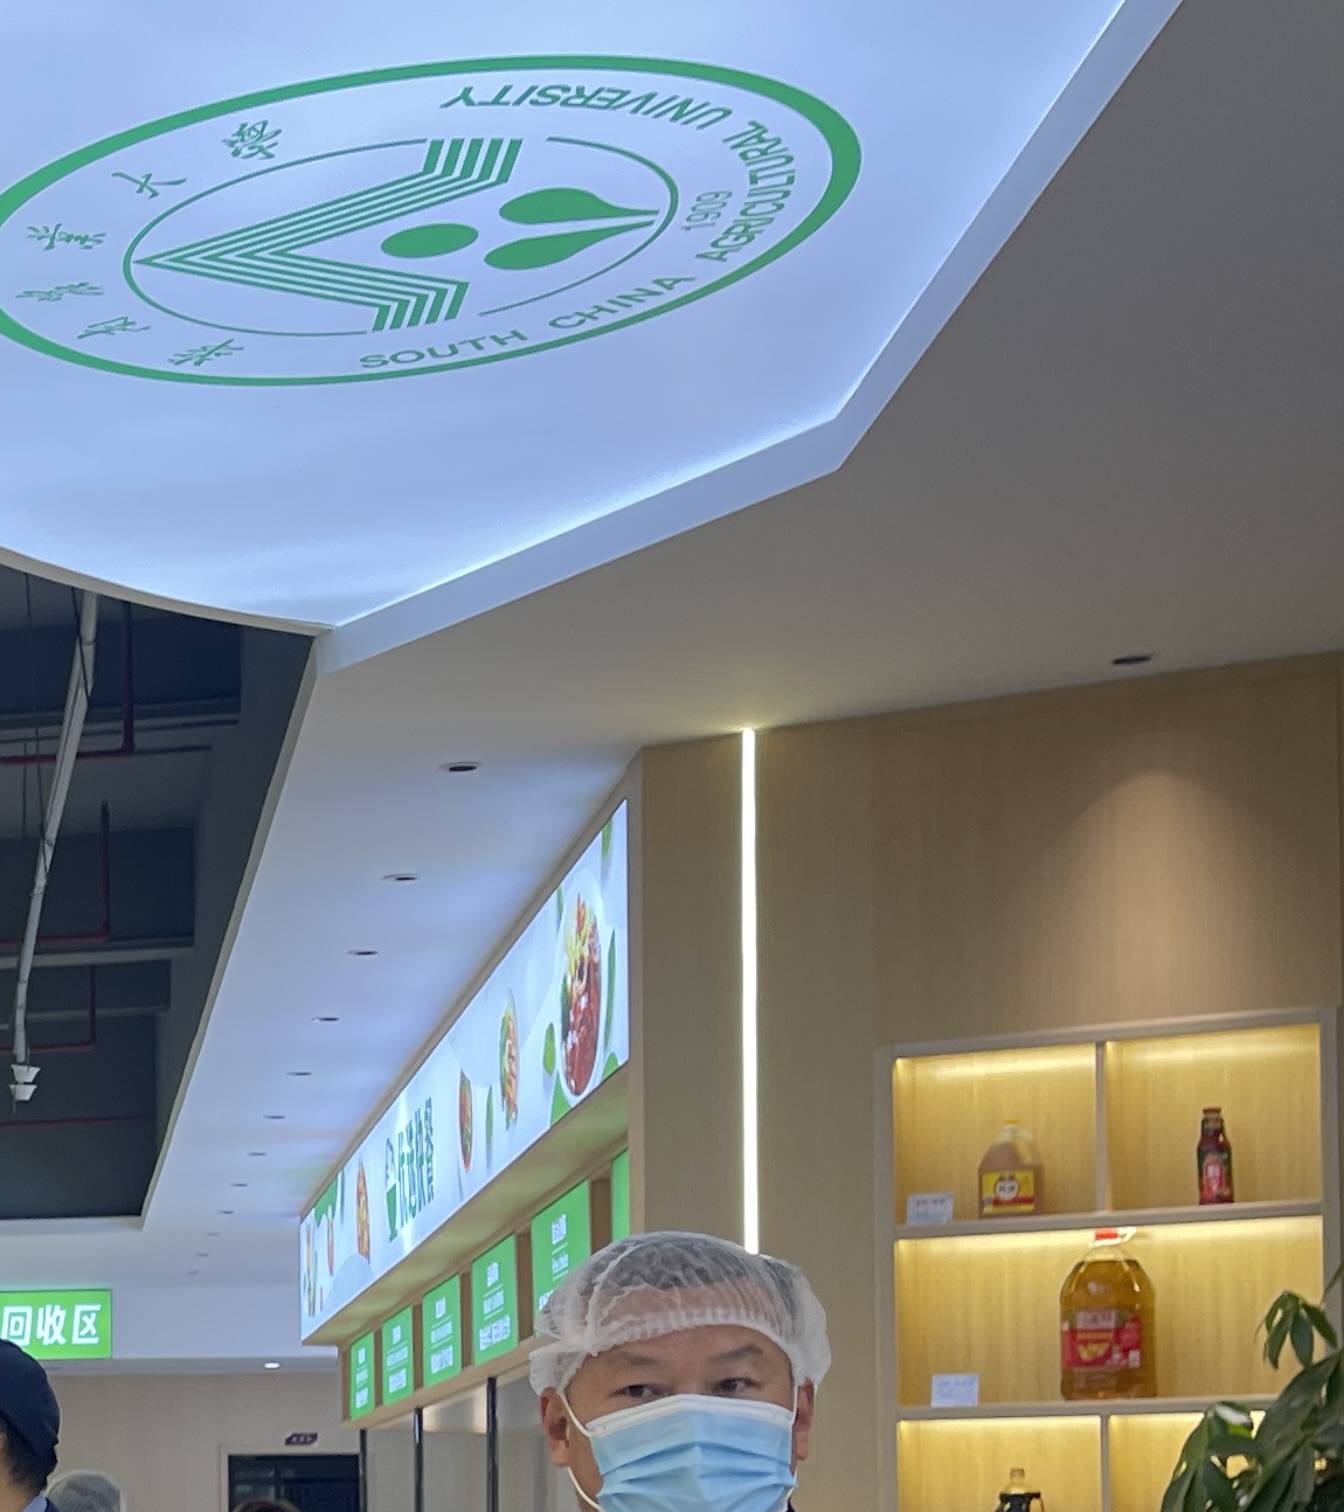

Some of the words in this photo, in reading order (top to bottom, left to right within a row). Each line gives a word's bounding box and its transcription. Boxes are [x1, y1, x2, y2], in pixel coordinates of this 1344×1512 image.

[438, 84, 734, 130] UNIVERSITY
[681, 189, 733, 231] 1909
[695, 120, 797, 263] AGRICULTURAL
[548, 274, 698, 329] CHINA
[359, 329, 528, 369] SOUTH
